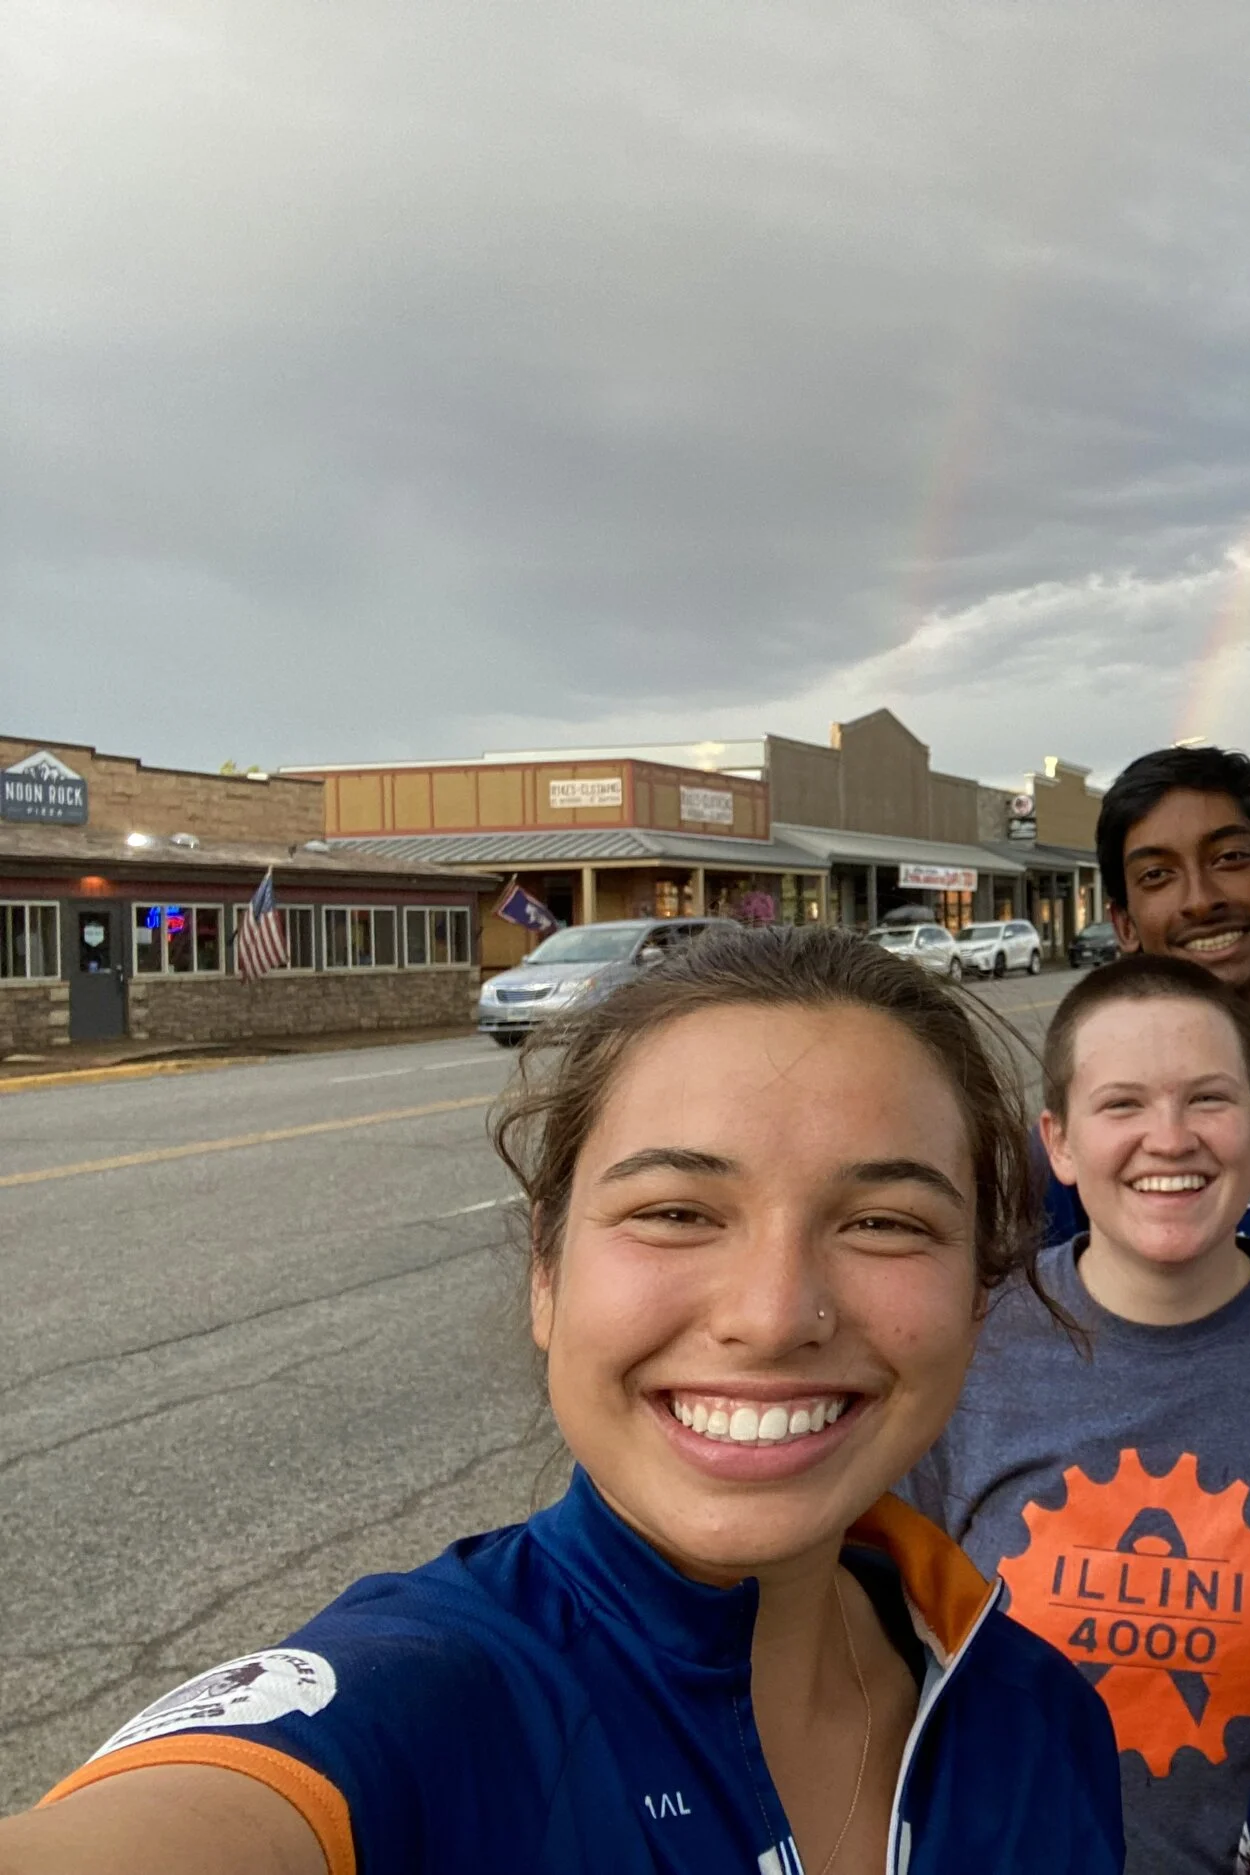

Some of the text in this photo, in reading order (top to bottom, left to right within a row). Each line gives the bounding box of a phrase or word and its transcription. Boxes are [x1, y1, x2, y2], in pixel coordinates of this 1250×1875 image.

[5, 781, 83, 806] NOON ROCK
[1051, 1555, 1243, 1613] ILLINI
[1068, 1617, 1217, 1664] 4000
